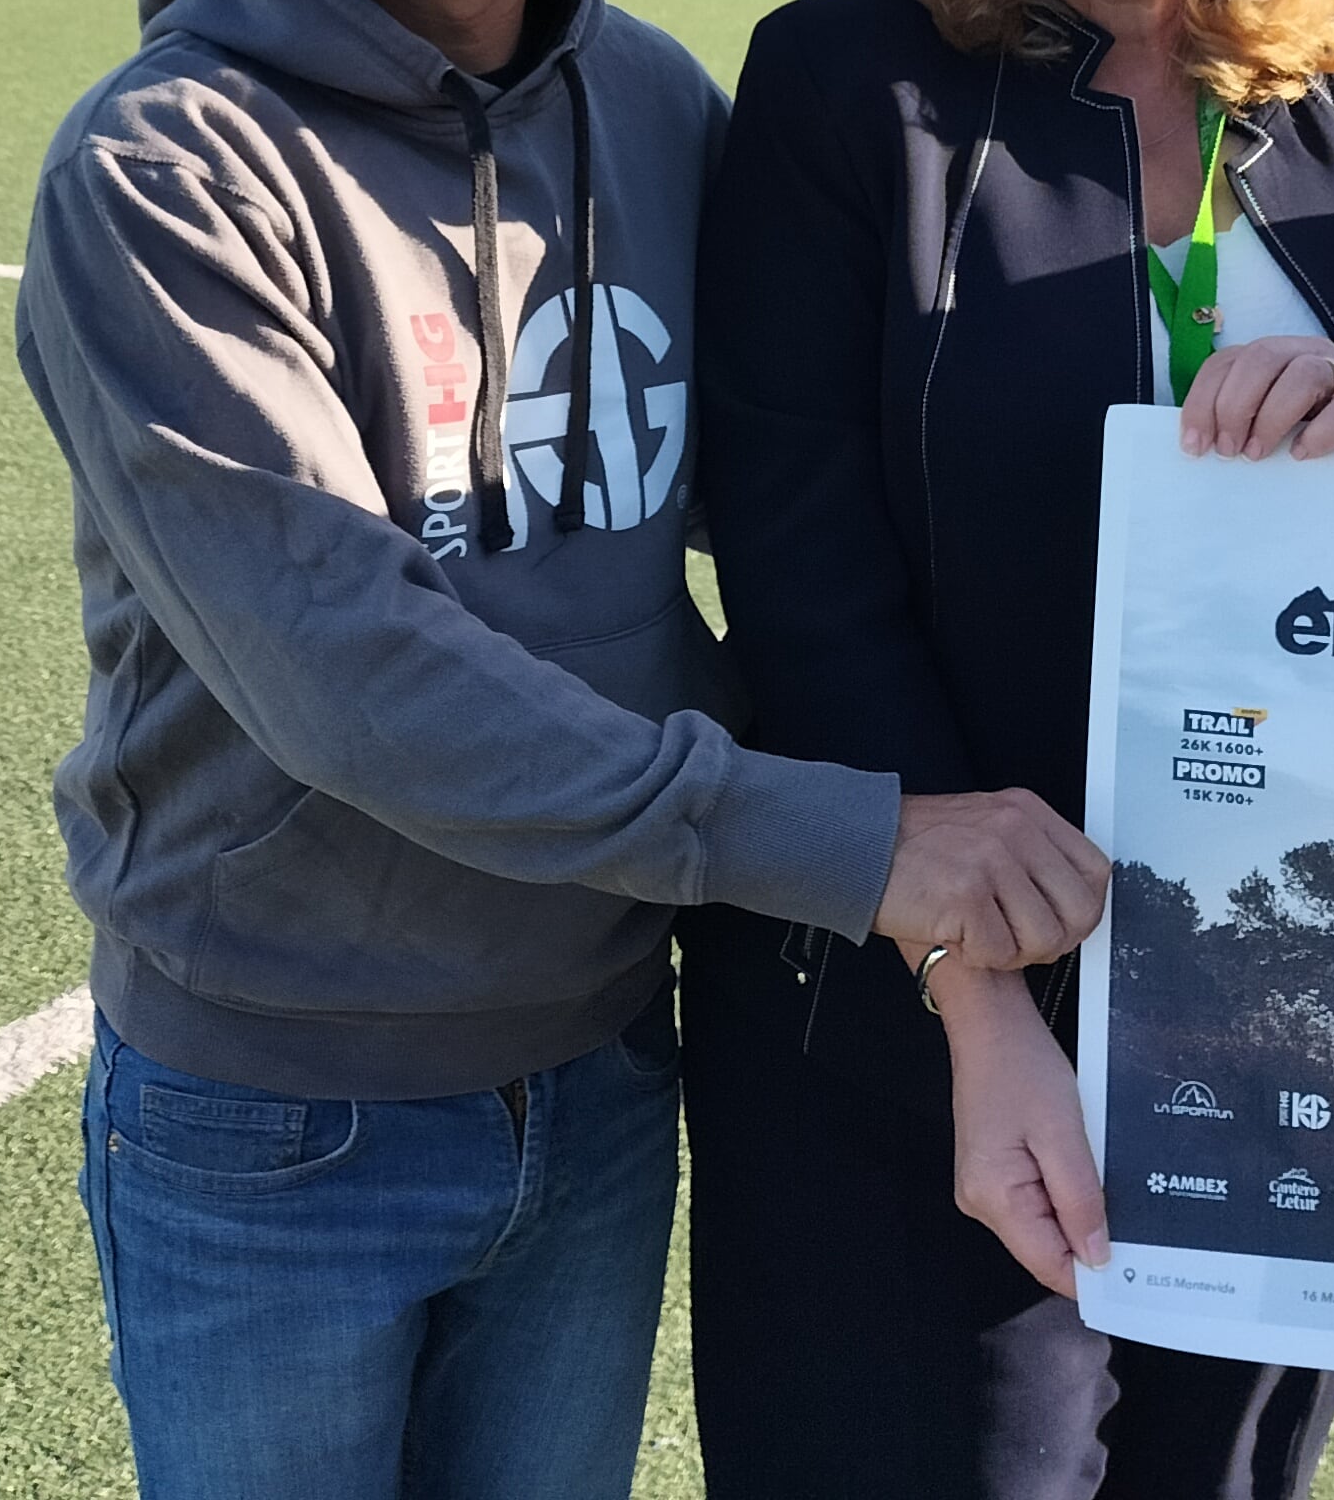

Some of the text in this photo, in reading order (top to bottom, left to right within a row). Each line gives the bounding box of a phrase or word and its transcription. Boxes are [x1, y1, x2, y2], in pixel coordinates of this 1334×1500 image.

[1188, 713, 1250, 735] TRAIL
[1180, 738, 1264, 756] 26K 1600+
[1176, 760, 1262, 785] PROMO
[1183, 788, 1254, 806] 15K 700+
[1168, 1174, 1229, 1195] AMBEX
[1268, 1180, 1320, 1197] Cantero
[1146, 1274, 1236, 1295] ELIS Montevida
[1302, 1289, 1317, 1302] 16
